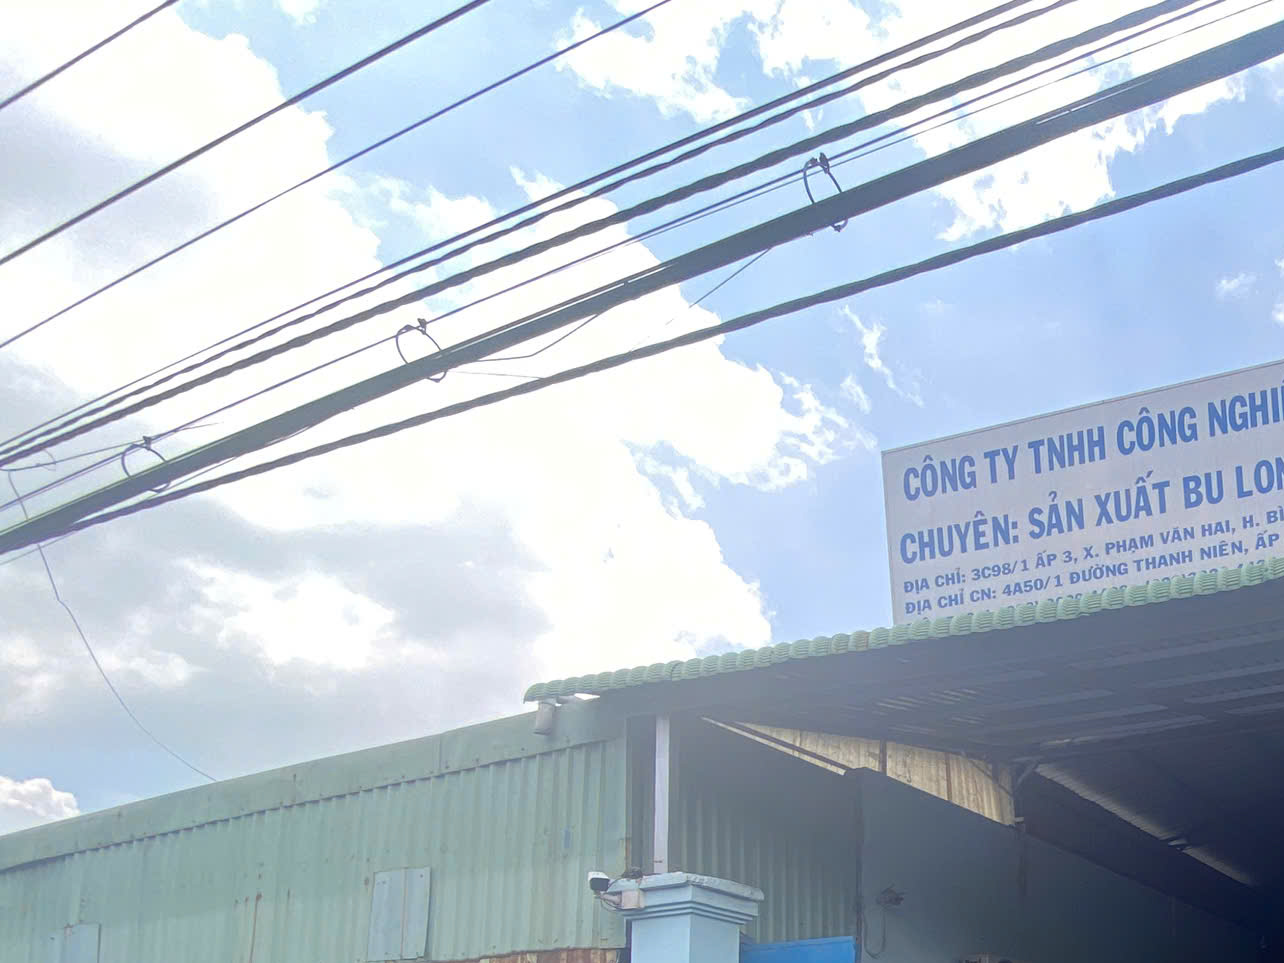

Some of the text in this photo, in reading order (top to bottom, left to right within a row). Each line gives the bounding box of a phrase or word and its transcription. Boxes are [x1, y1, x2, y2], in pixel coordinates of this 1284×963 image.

[903, 455, 976, 501] CÔNG
[984, 445, 1020, 484] TY
[1028, 426, 1106, 474] TNHH
[1116, 406, 1198, 456] CÔNG
[900, 510, 1020, 565] CHUYÊN:
[1028, 490, 1086, 540] SẢN
[1094, 470, 1171, 527] XUẤT
[1182, 470, 1224, 511] BU
[903, 577, 930, 595] ĐỊA
[934, 567, 966, 588] CHỈ:
[971, 557, 1030, 581] 3C98/1
[1035, 550, 1057, 569] ẤP
[1063, 550, 1078, 565] 3,
[1083, 545, 1099, 560] X.
[1105, 534, 1154, 556] PHẠM
[1160, 526, 1195, 546] VĂN
[1201, 519, 1236, 538] HAI,
[1242, 515, 1260, 529] H.
[905, 600, 931, 615] ĐỊA
[969, 588, 997, 603] CN:
[1002, 575, 1063, 598] 4A50/1
[1069, 561, 1129, 585] ĐƯỜNG
[1133, 550, 1193, 573] THANH
[1200, 540, 1249, 561] NIÊN,
[1255, 530, 1280, 551] ẤP
